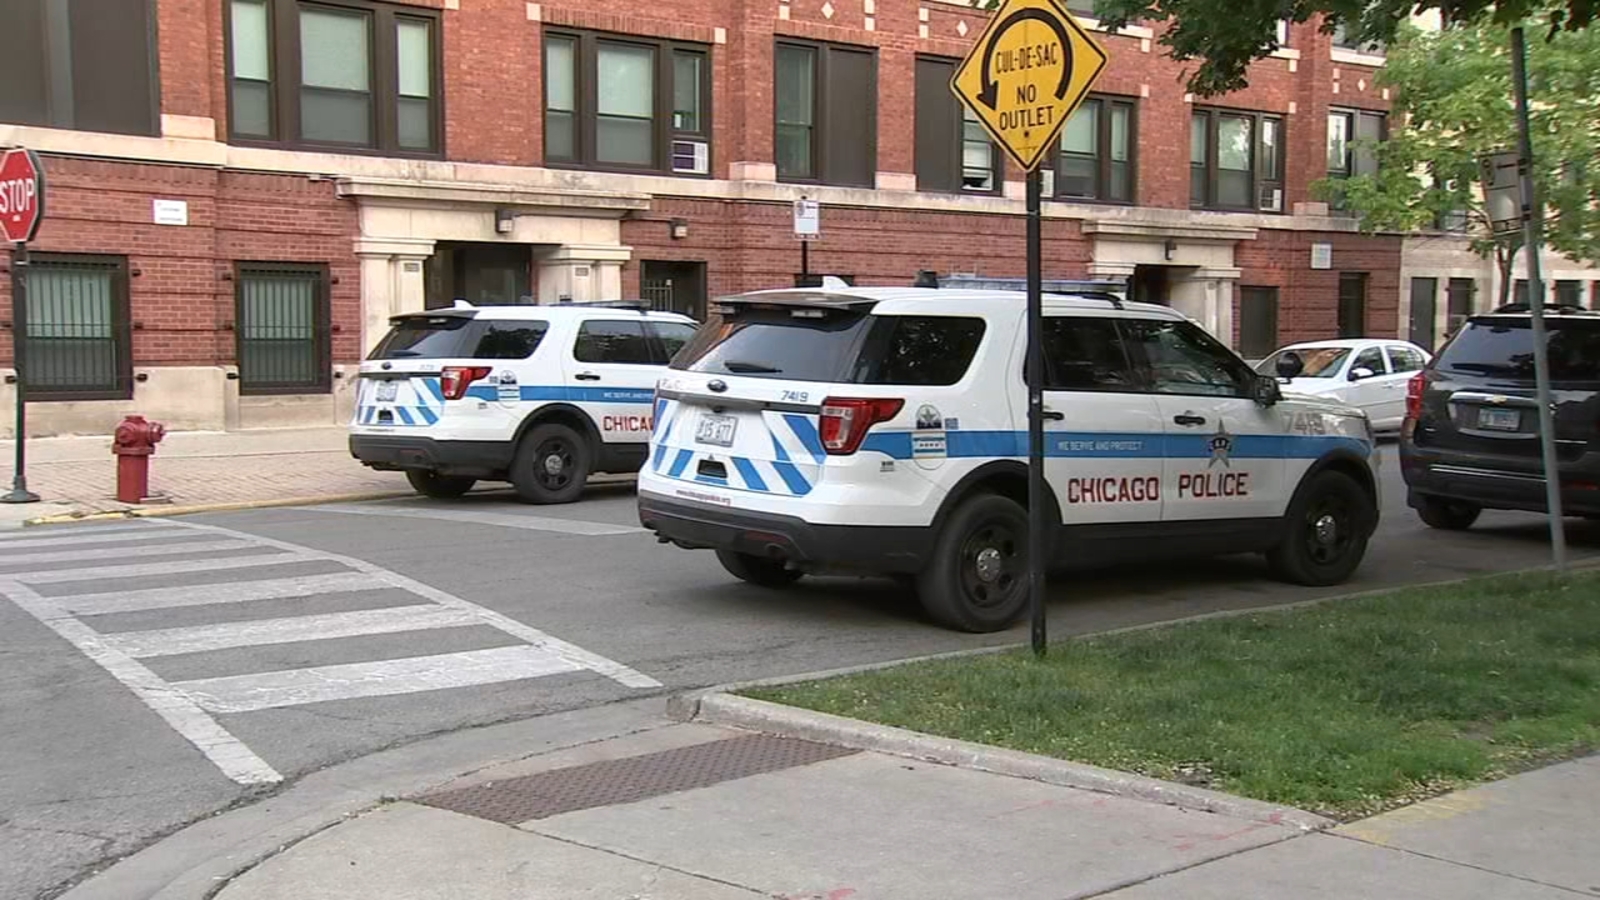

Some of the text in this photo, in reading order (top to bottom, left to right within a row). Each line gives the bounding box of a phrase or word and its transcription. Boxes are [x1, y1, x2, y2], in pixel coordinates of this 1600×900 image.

[996, 42, 1057, 74] CUL-DE-SAC
[1016, 84, 1036, 105] NO
[1000, 105, 1054, 131] OUTLET
[0, 178, 35, 213] STOP
[780, 389, 809, 402] 7419
[1068, 472, 1249, 503] CHICAGO POLICE
